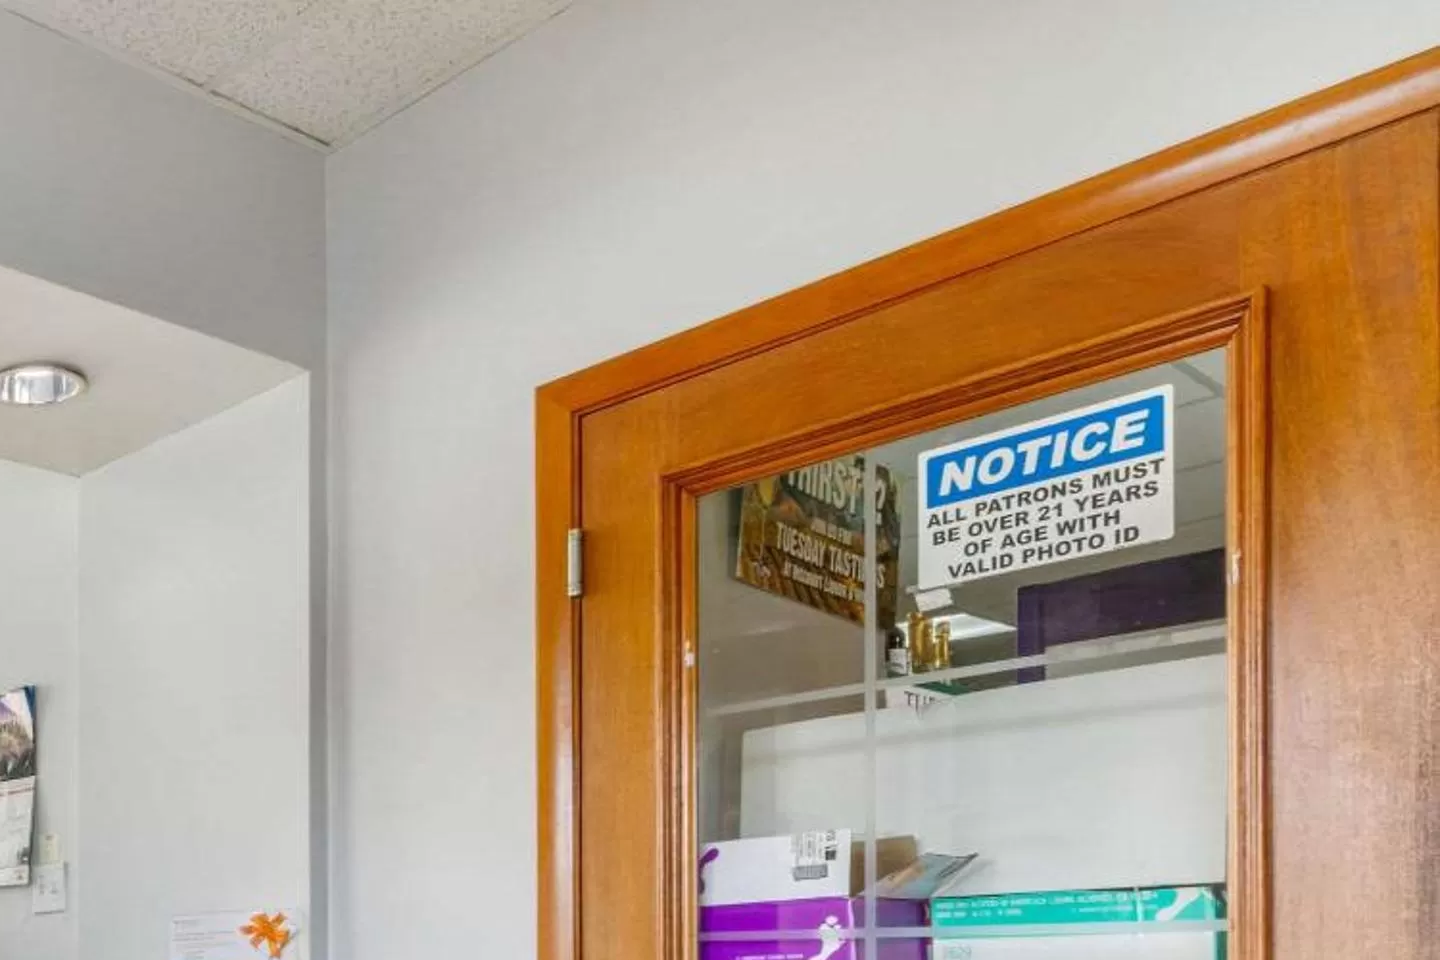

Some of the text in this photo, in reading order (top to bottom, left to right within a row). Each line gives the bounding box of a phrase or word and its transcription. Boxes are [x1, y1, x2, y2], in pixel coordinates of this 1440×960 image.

[938, 409, 1150, 497] NOTICE
[927, 458, 1166, 528] ALL PATRONS MUST
[933, 481, 1159, 546] BE OVER 21 YEARS
[776, 521, 826, 569] TUESDAY
[948, 525, 1140, 579] VALID PHOTO ID
[964, 509, 1122, 557] OF AGE WITH
